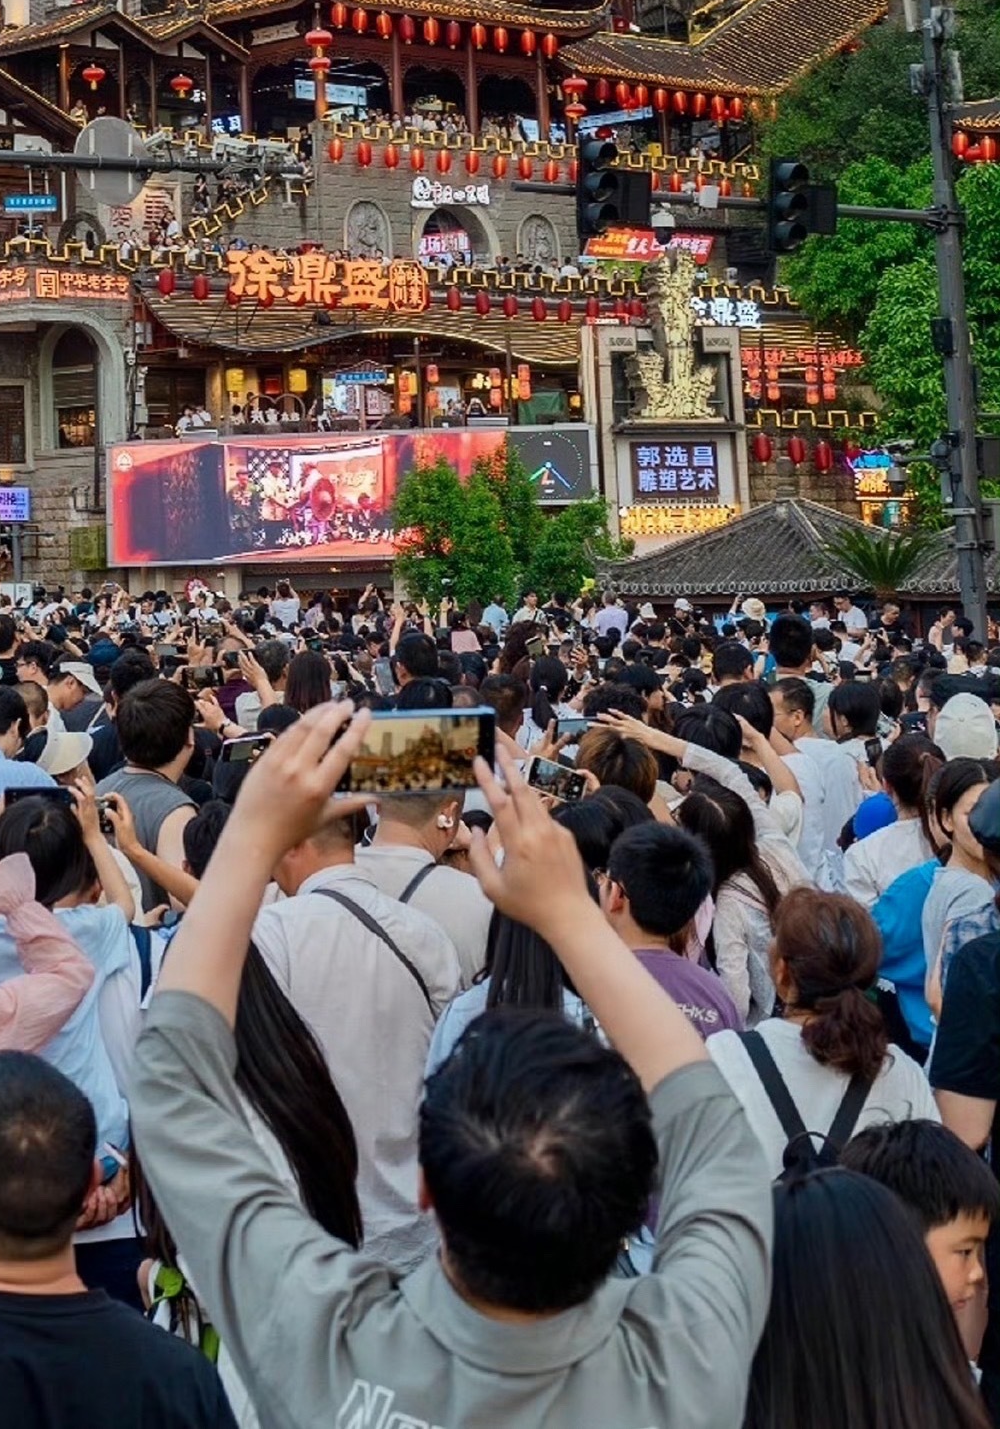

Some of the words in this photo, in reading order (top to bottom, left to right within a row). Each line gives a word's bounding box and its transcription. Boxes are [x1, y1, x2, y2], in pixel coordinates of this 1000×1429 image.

[59, 272, 129, 292] 中华老字号
[226, 250, 390, 309] 徐鼎盛
[636, 445, 714, 467] 郭选昌
[638, 468, 716, 492] 雕塑艺术
[678, 1002, 718, 1024] HKS
